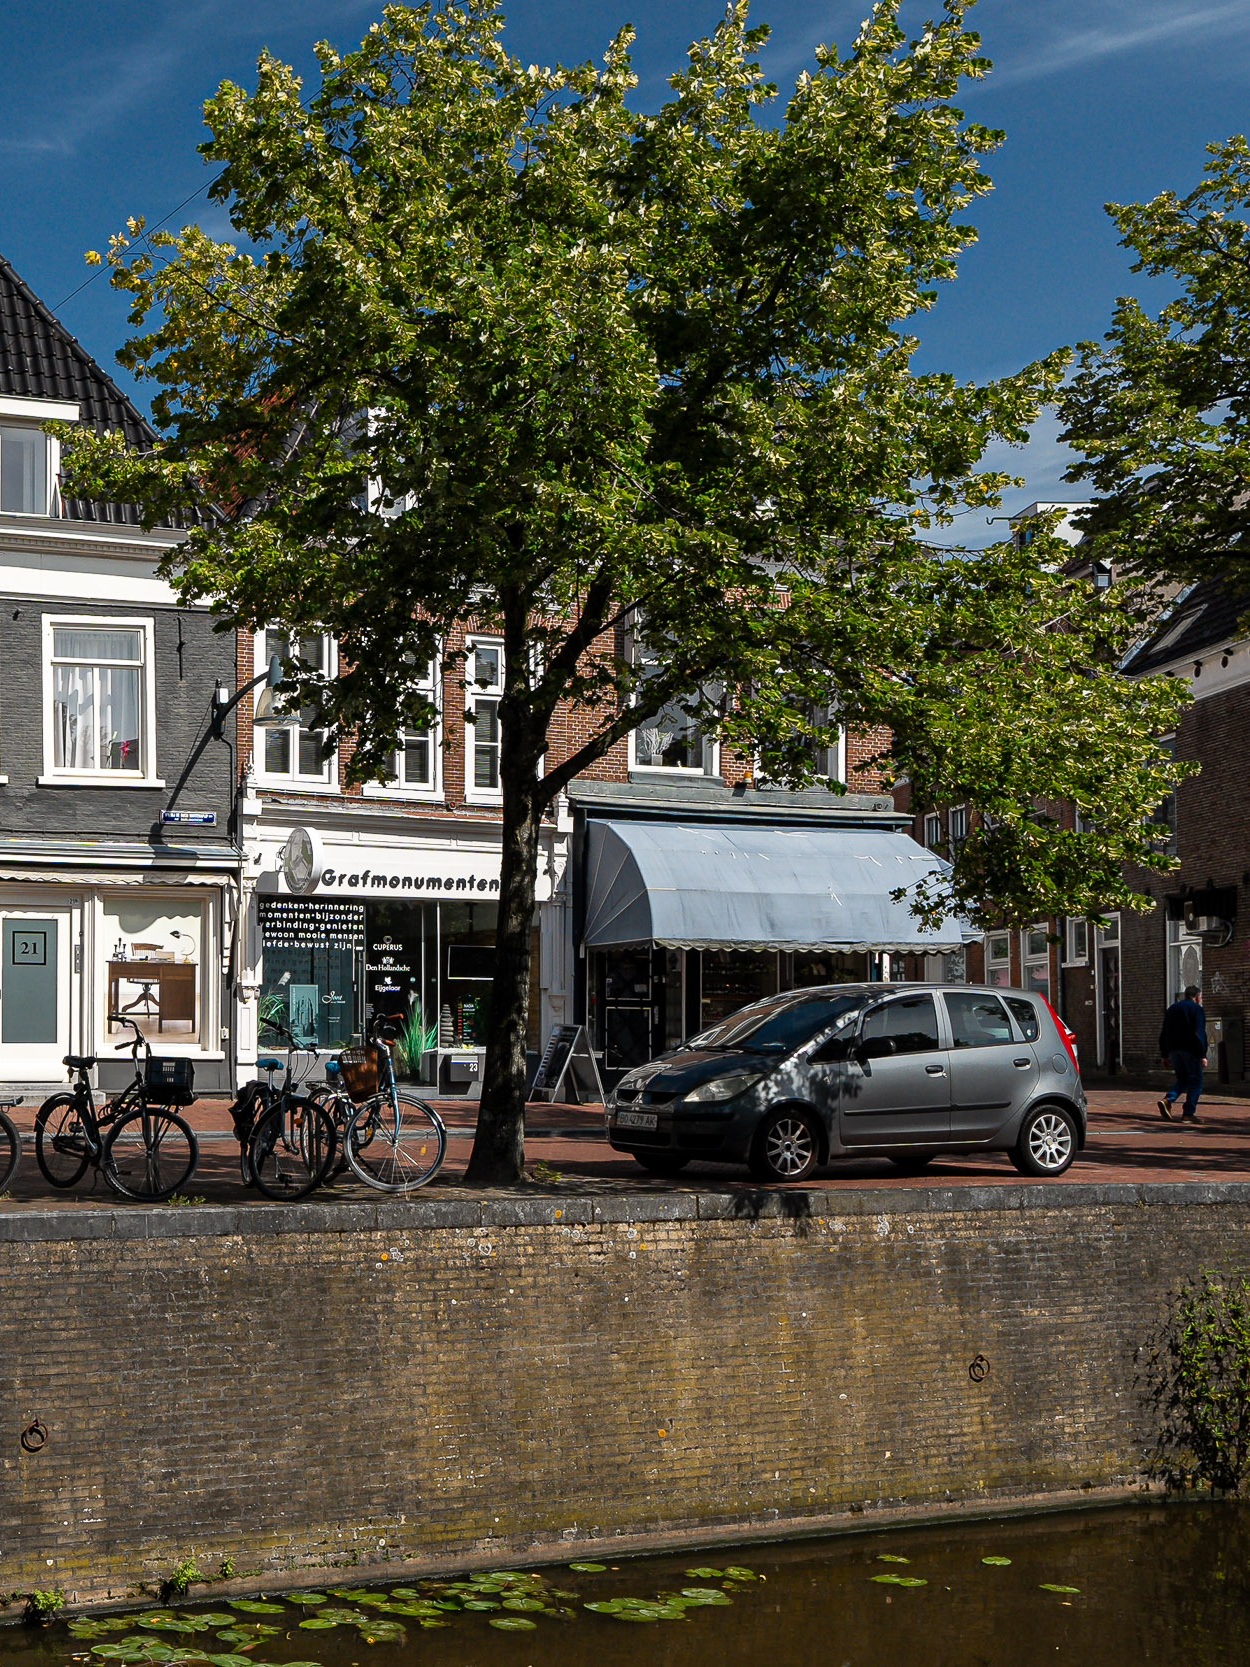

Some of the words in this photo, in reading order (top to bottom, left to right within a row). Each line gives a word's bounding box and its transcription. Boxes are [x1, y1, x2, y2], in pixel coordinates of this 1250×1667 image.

[321, 868, 499, 892] Grafmonumenten
[298, 931, 326, 939] mooie
[330, 932, 364, 940] mensen
[19, 940, 38, 954] 21
[372, 943, 403, 951] CUPERUS
[469, 1063, 478, 1072] 23
